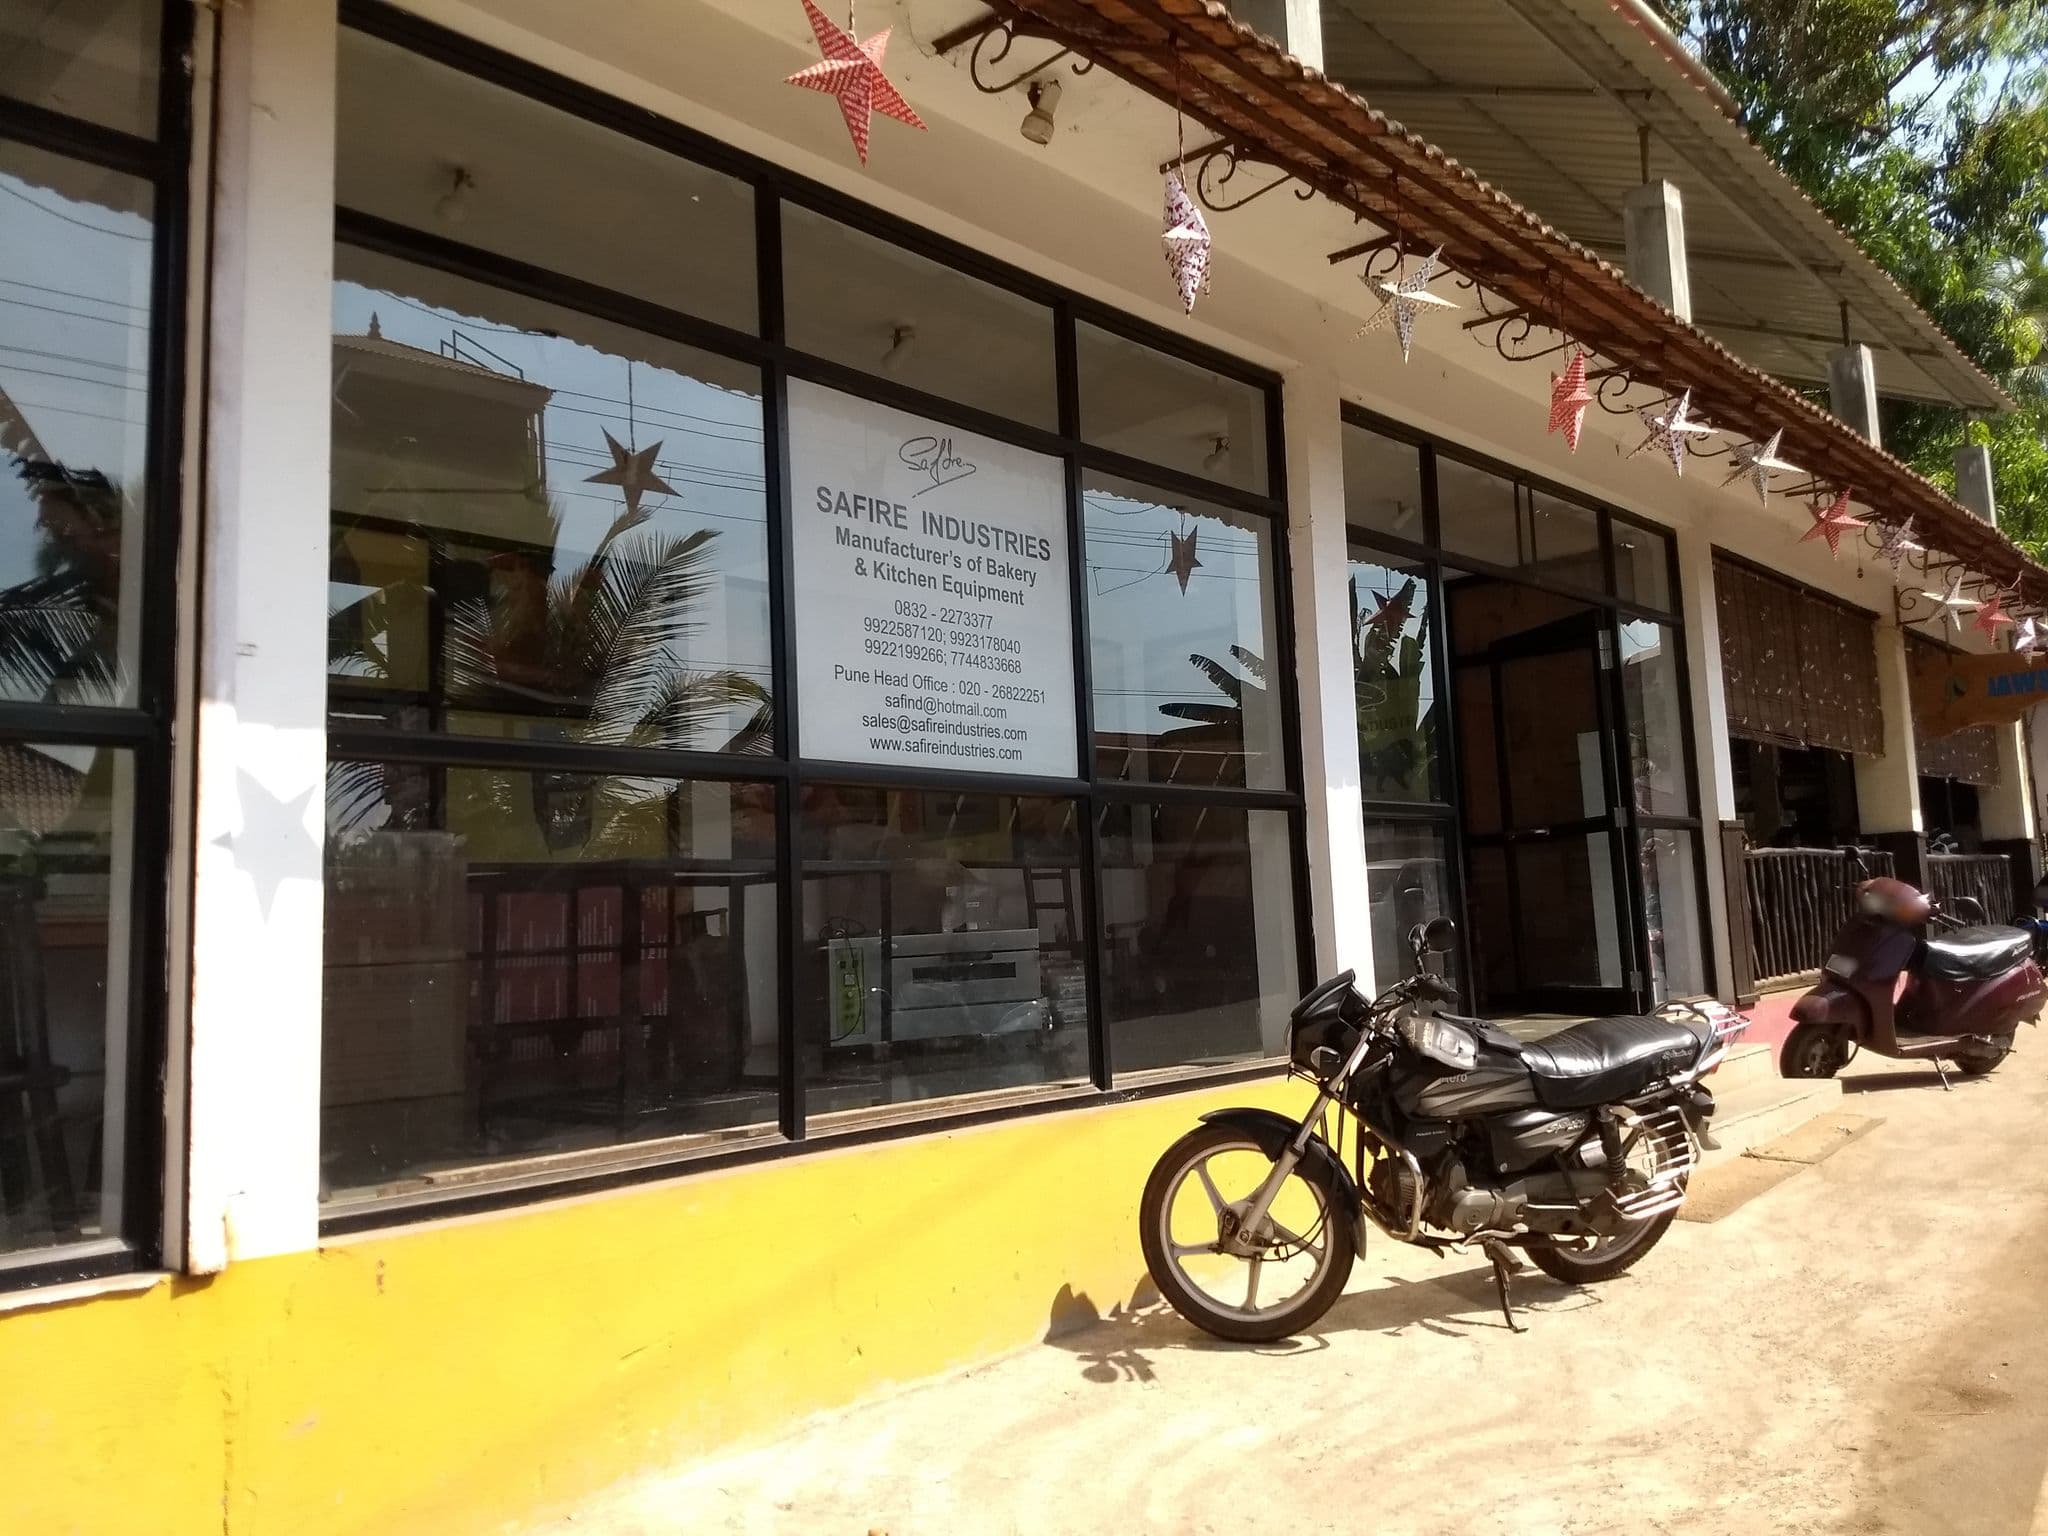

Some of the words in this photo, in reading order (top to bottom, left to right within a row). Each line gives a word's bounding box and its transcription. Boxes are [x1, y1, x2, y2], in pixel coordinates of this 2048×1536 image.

[816, 486, 908, 530] SAFIRE
[922, 510, 1051, 561] INDUSTRIES
[835, 525, 962, 569] Manufacturer's
[967, 555, 982, 573] of
[986, 557, 1037, 588] Bakery
[854, 557, 868, 577] &
[873, 560, 937, 590] Kitchen
[942, 574, 1025, 606] Equipment
[894, 599, 928, 619] 0832
[940, 607, 993, 630] 2273377
[863, 616, 946, 645] 9922587120;
[950, 630, 1021, 655] 9923178040
[864, 638, 947, 666] 9922199266;
[951, 651, 1022, 674] 7744833668
[834, 664, 870, 683] Pune
[874, 669, 909, 688] Head
[912, 674, 948, 693] Office
[959, 680, 981, 697] 020
[992, 684, 1046, 704] 26822251
[885, 694, 1007, 719] safind@hotmail.com
[862, 713, 1028, 741] sales@safireindustries.com
[869, 737, 1023, 761] www.safireindustries.com
